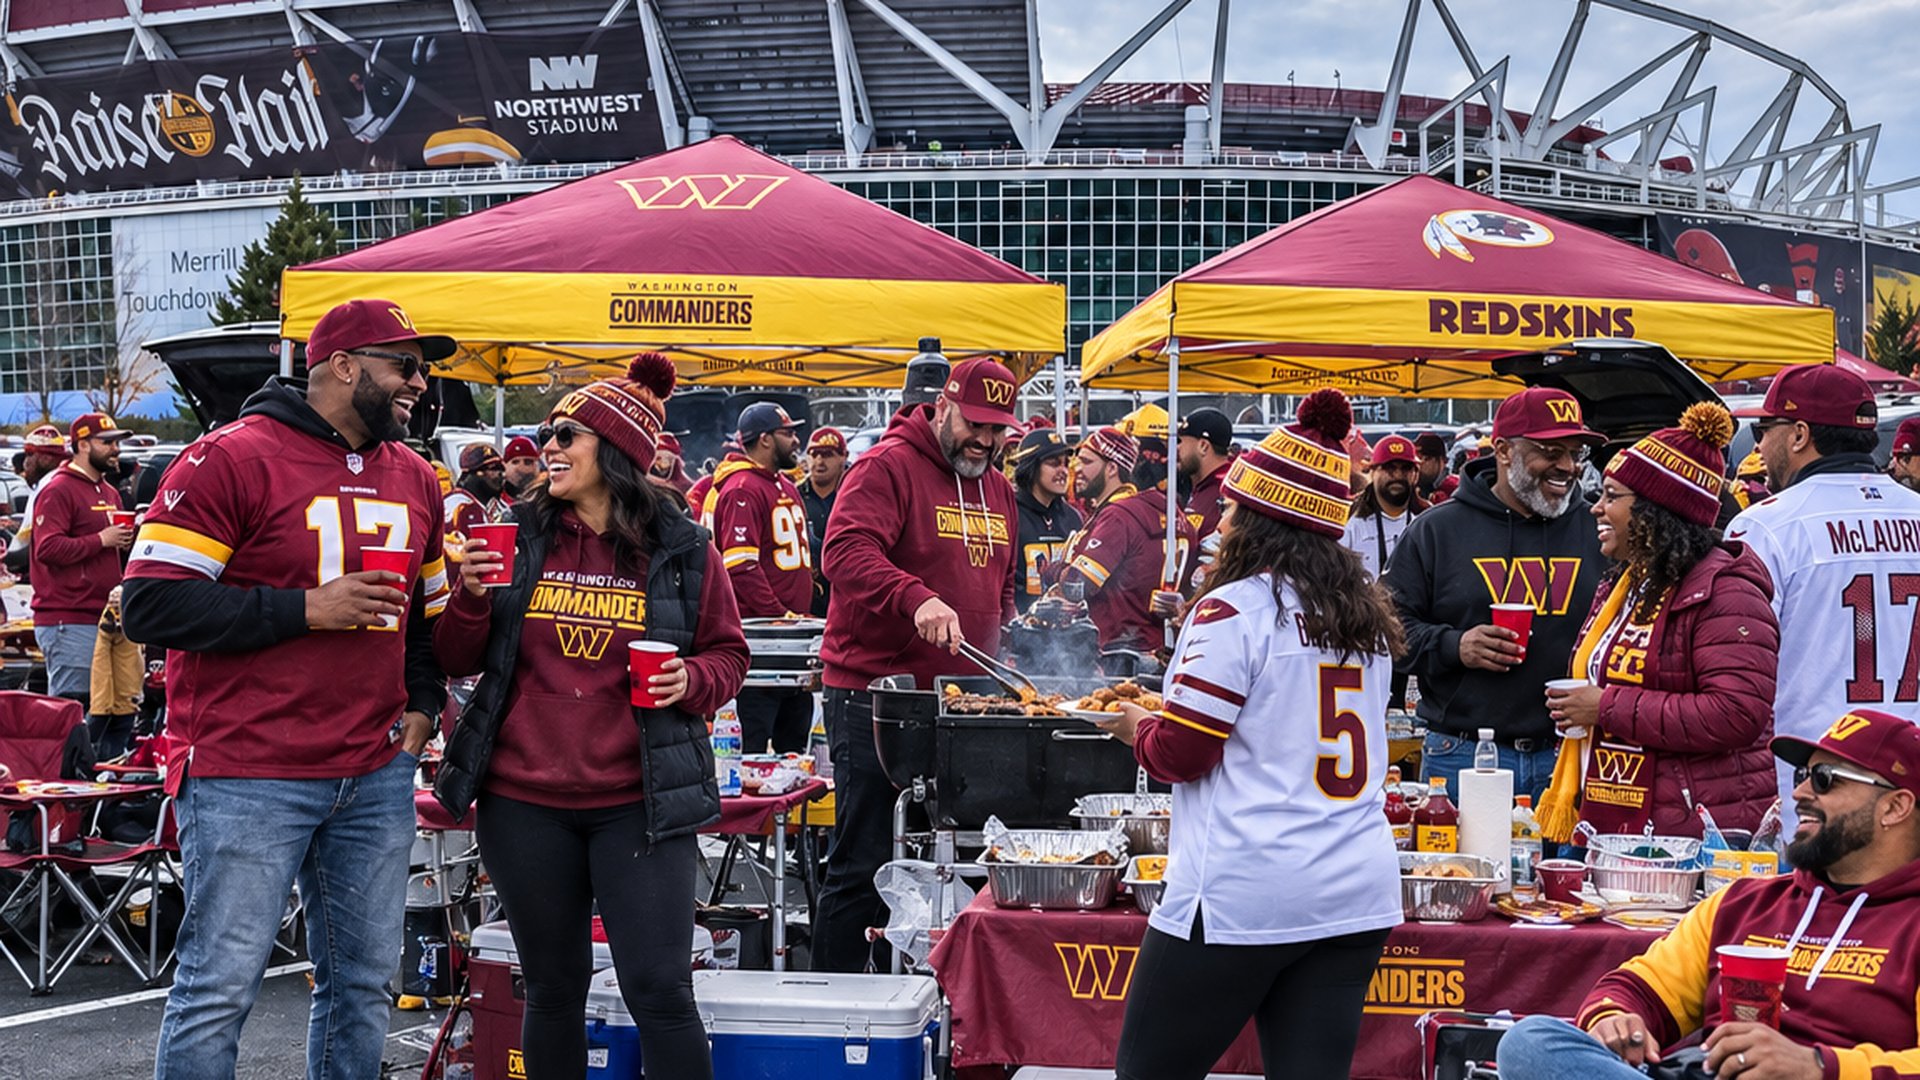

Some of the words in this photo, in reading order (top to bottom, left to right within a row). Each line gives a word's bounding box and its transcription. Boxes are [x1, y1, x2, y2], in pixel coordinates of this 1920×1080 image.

[529, 54, 598, 91] NW
[494, 94, 643, 118] NORTHWEST
[18, 90, 174, 183] Raise
[526, 116, 618, 135] STADIUM
[171, 247, 238, 274] Merrill
[122, 286, 226, 313] Touchdow
[628, 283, 738, 292] WASHINGTON
[609, 299, 753, 324] COMMANDERS
[1428, 298, 1635, 338] REDSKINS
[771, 505, 811, 571] 93
[1826, 519, 1920, 555] McLAURI
[304, 496, 411, 632] 17
[529, 586, 646, 622] OMMANDER
[1841, 573, 1920, 704] 17
[1314, 662, 1369, 801] 5
[1364, 967, 1466, 1006] NDERS
